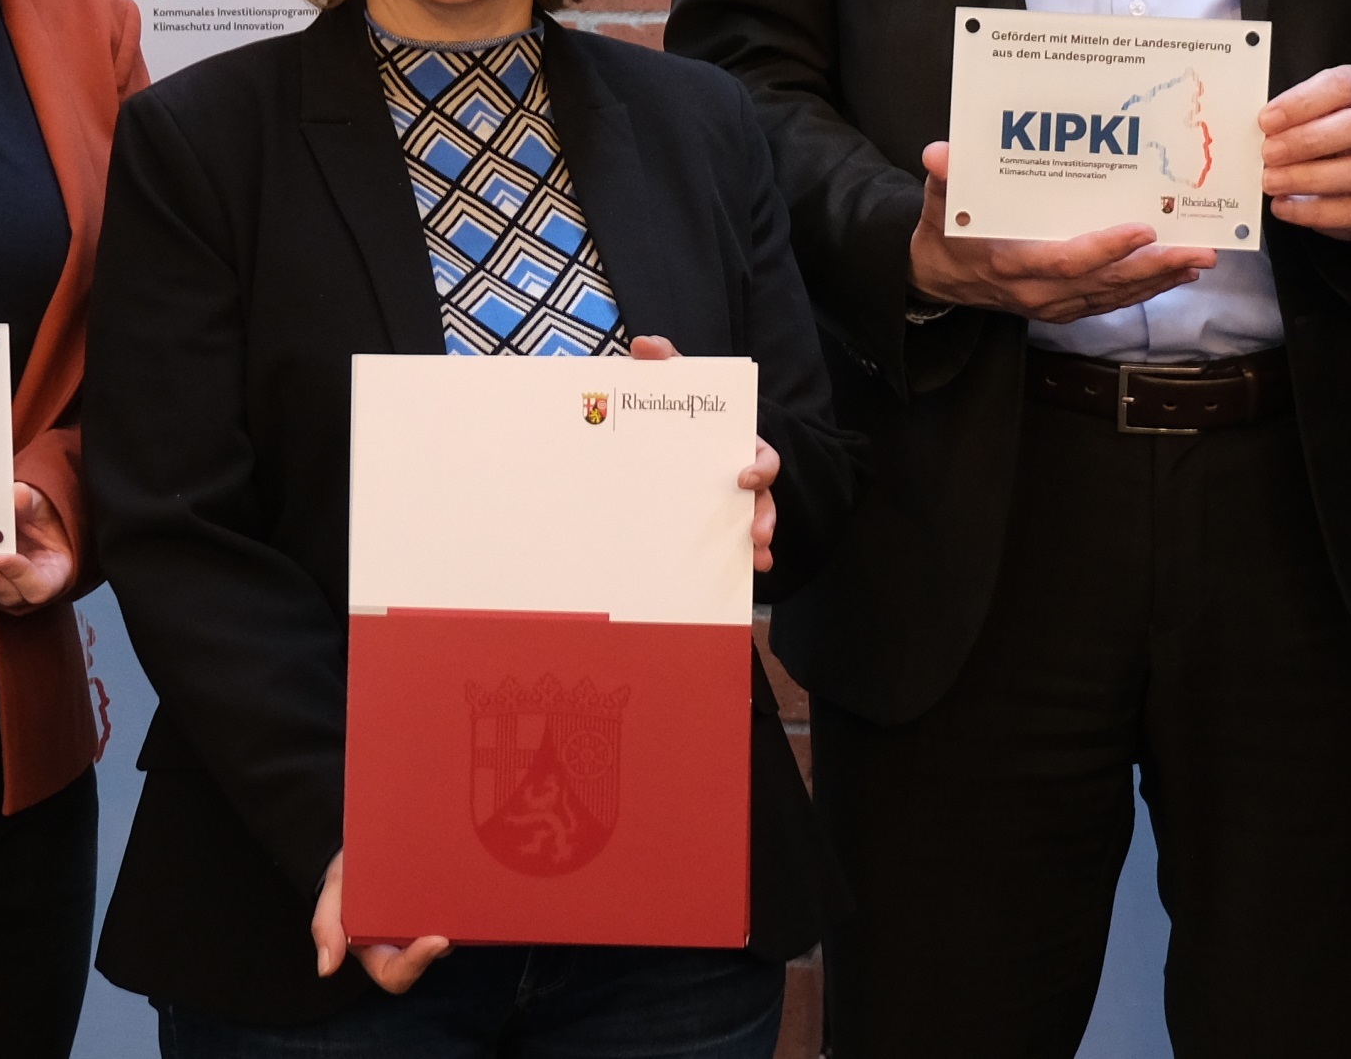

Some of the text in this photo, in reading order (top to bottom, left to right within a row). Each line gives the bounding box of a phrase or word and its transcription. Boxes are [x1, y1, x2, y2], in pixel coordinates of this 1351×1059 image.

[154, 8, 320, 18] Kommunales Investitionsprogramm
[154, 23, 284, 31] Klimaschutz und Innovation
[992, 30, 1231, 53] Gefördert mit Mitteln der Landesregierung
[992, 48, 1145, 65] aus dem Landesprogramm
[1001, 110, 1139, 155] KIPKI
[1000, 157, 1137, 170] Kommunales Investitionsprogramm
[999, 168, 1106, 180] Klimaschutz und Innovation
[622, 393, 726, 418] RheinlandPfalz
